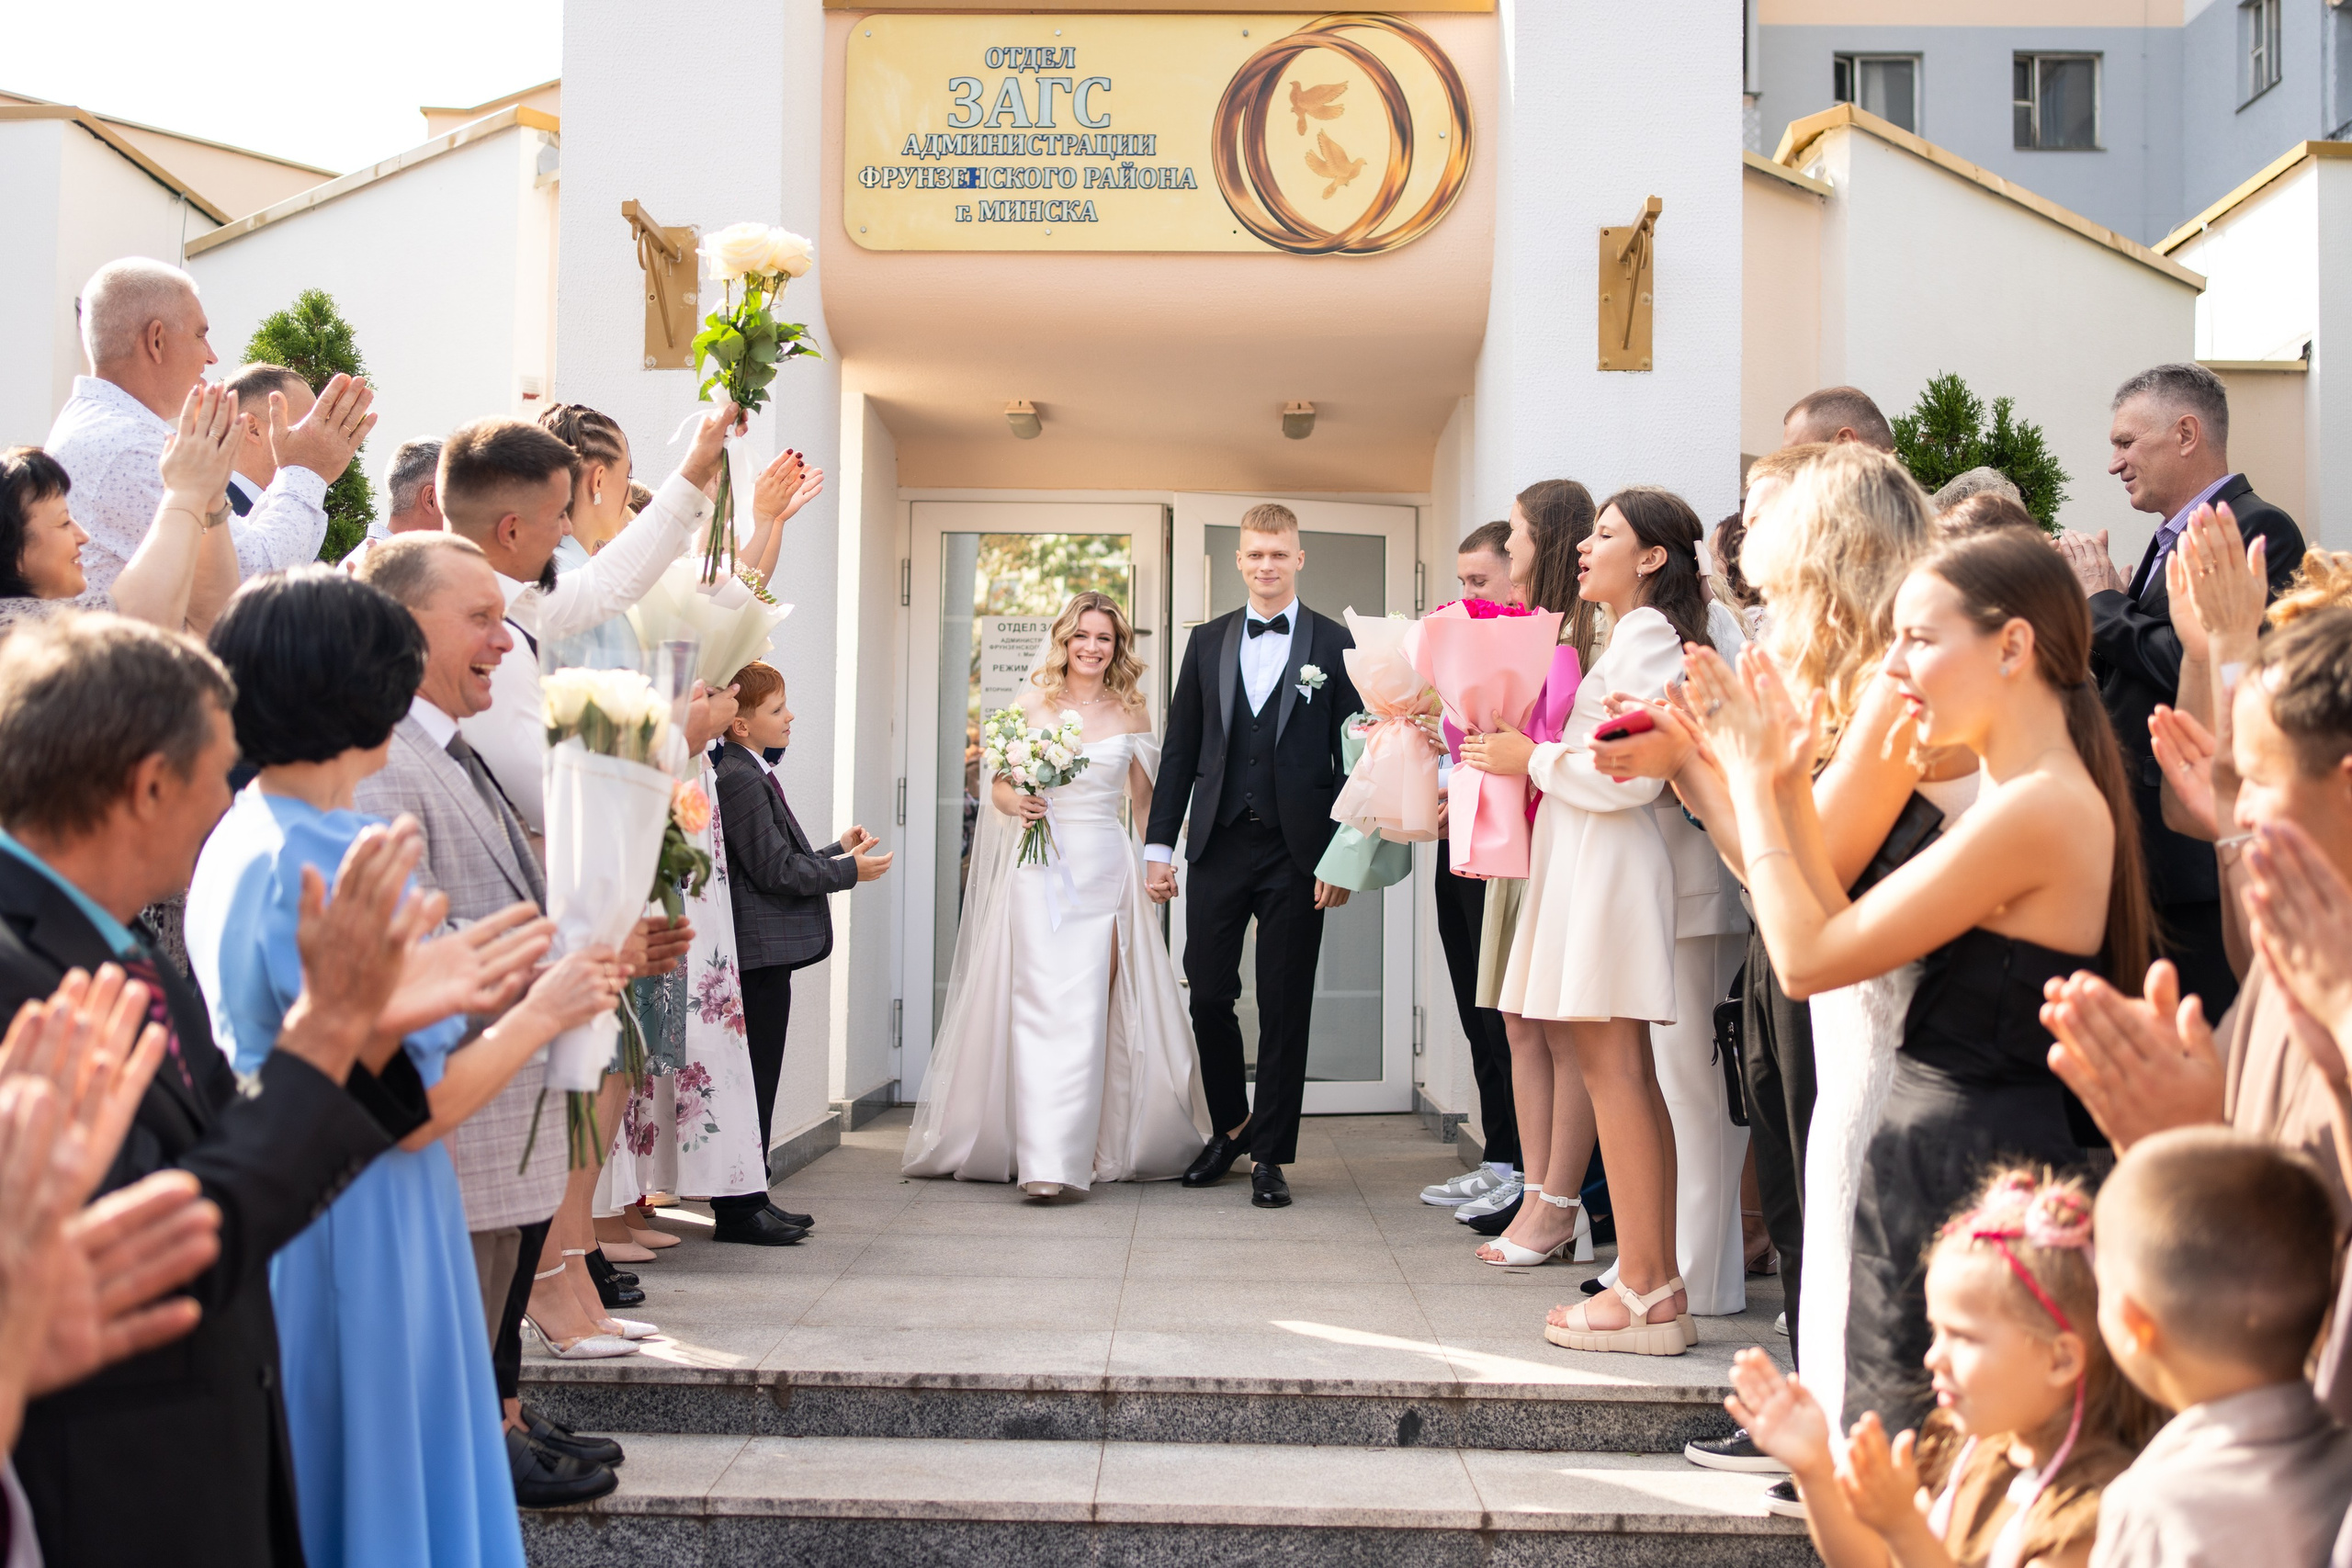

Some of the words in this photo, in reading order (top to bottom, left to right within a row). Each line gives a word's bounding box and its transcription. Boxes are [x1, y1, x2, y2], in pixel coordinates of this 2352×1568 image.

[985, 46, 1076, 73] ОТДЕЛ
[947, 76, 1112, 129] ЗАГС
[901, 133, 1157, 160] АДМИНИСТРАЦИИ
[858, 166, 1078, 189] ФРУНЗЕНСКОГО
[1083, 162, 1197, 189] РАЙОНА
[956, 205, 972, 222] г.
[978, 200, 1099, 222] МИНСКА
[998, 623, 1036, 633] ОТДЕЛ
